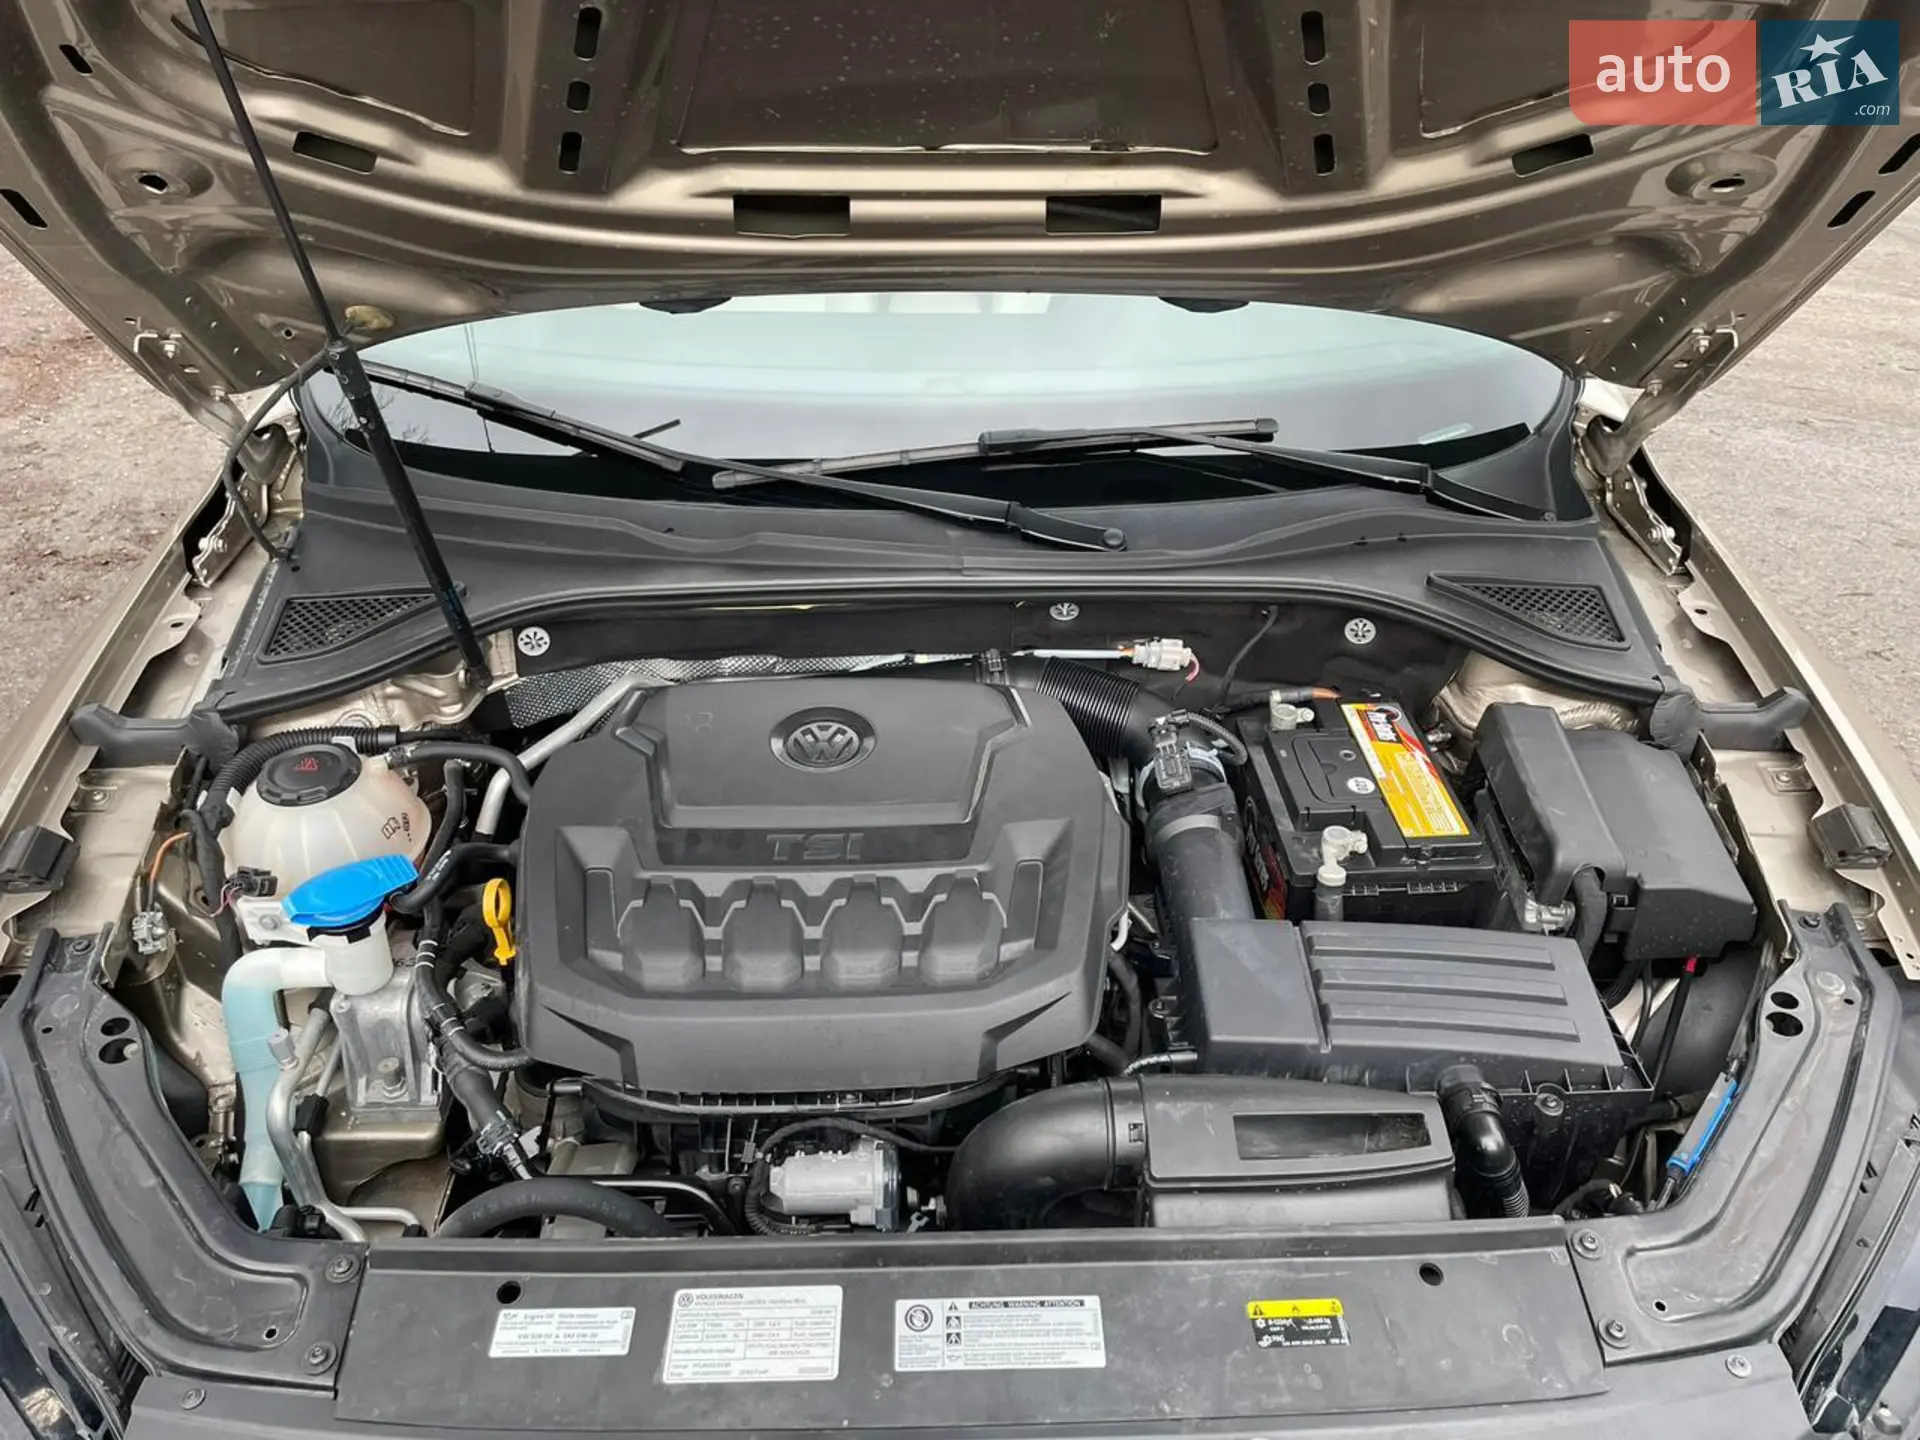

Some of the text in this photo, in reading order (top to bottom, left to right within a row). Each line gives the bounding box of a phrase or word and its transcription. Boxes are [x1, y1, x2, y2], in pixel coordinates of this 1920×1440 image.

[766, 832, 865, 861] TSI
[972, 1299, 1081, 1309] ACHTUNG WARNING ATTENTION
